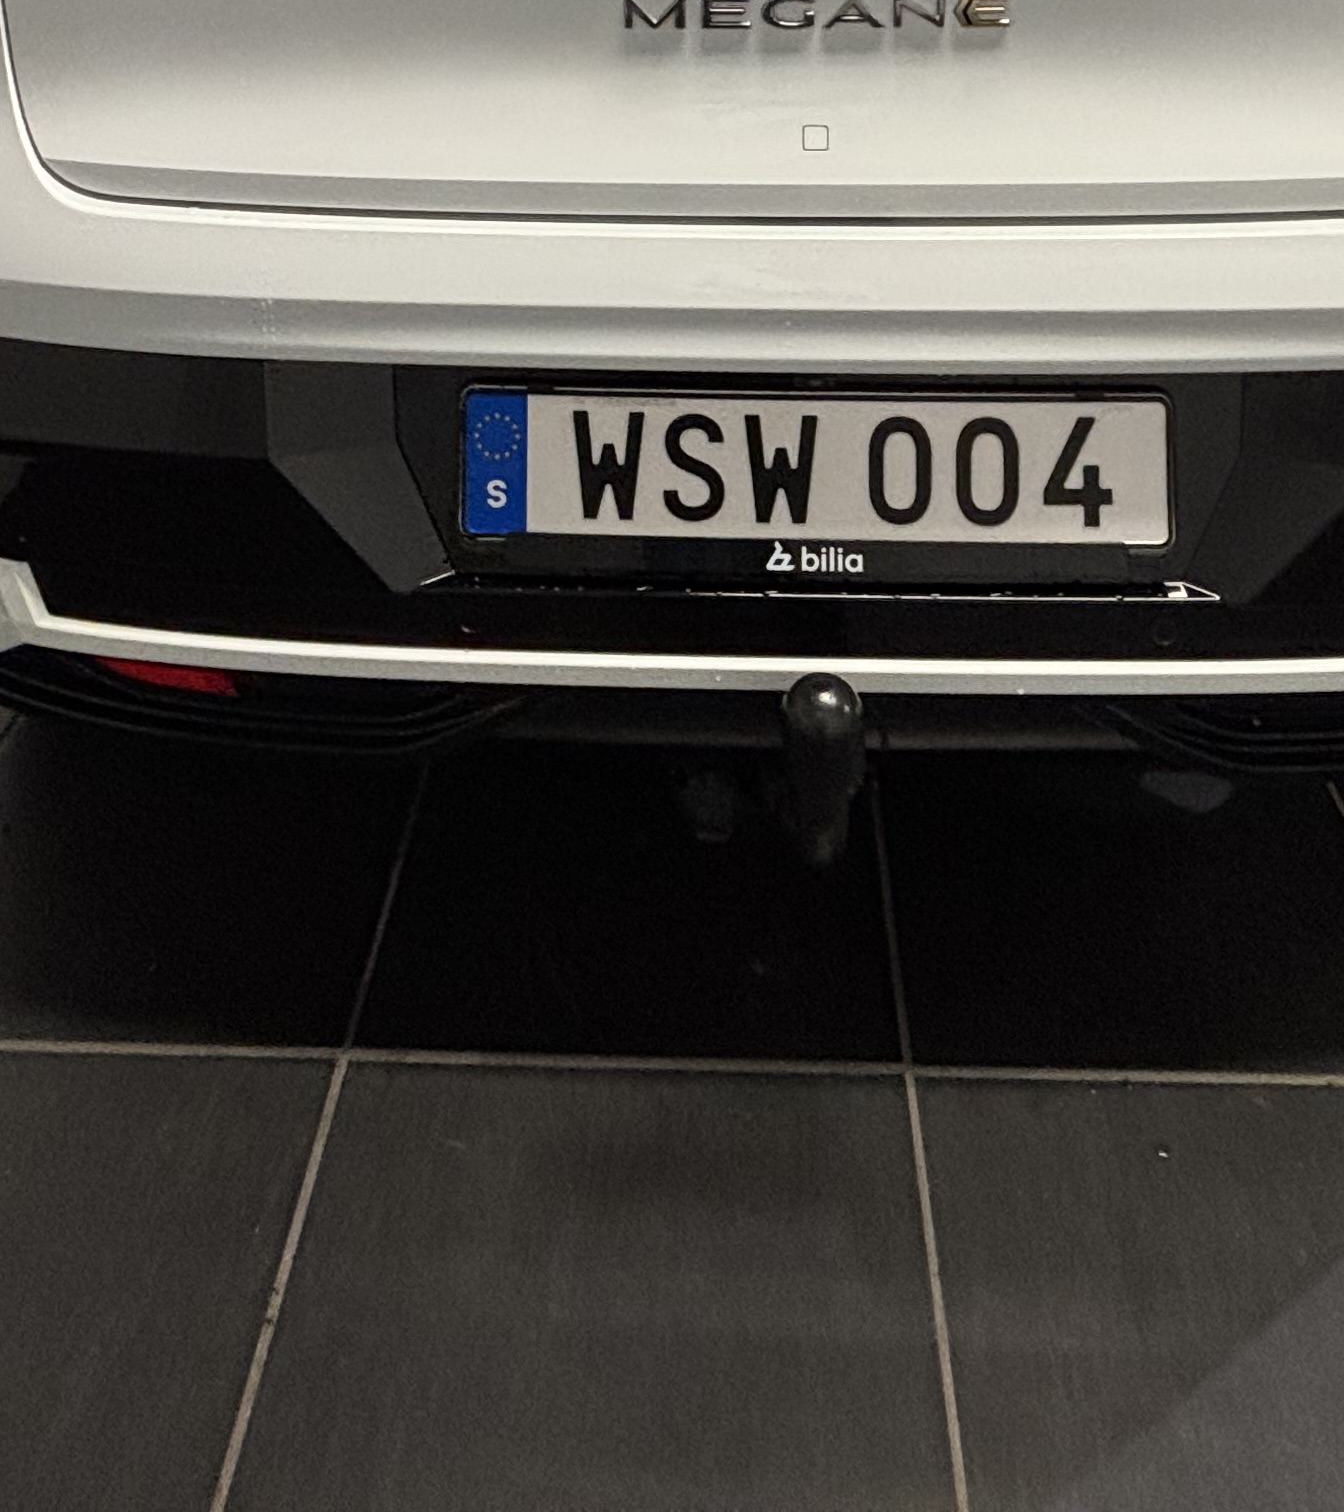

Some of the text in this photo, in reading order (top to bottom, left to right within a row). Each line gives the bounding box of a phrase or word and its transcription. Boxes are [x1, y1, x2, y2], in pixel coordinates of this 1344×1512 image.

[573, 410, 1114, 528] WSW 004
[486, 479, 507, 509] S
[800, 545, 864, 574] bilia
